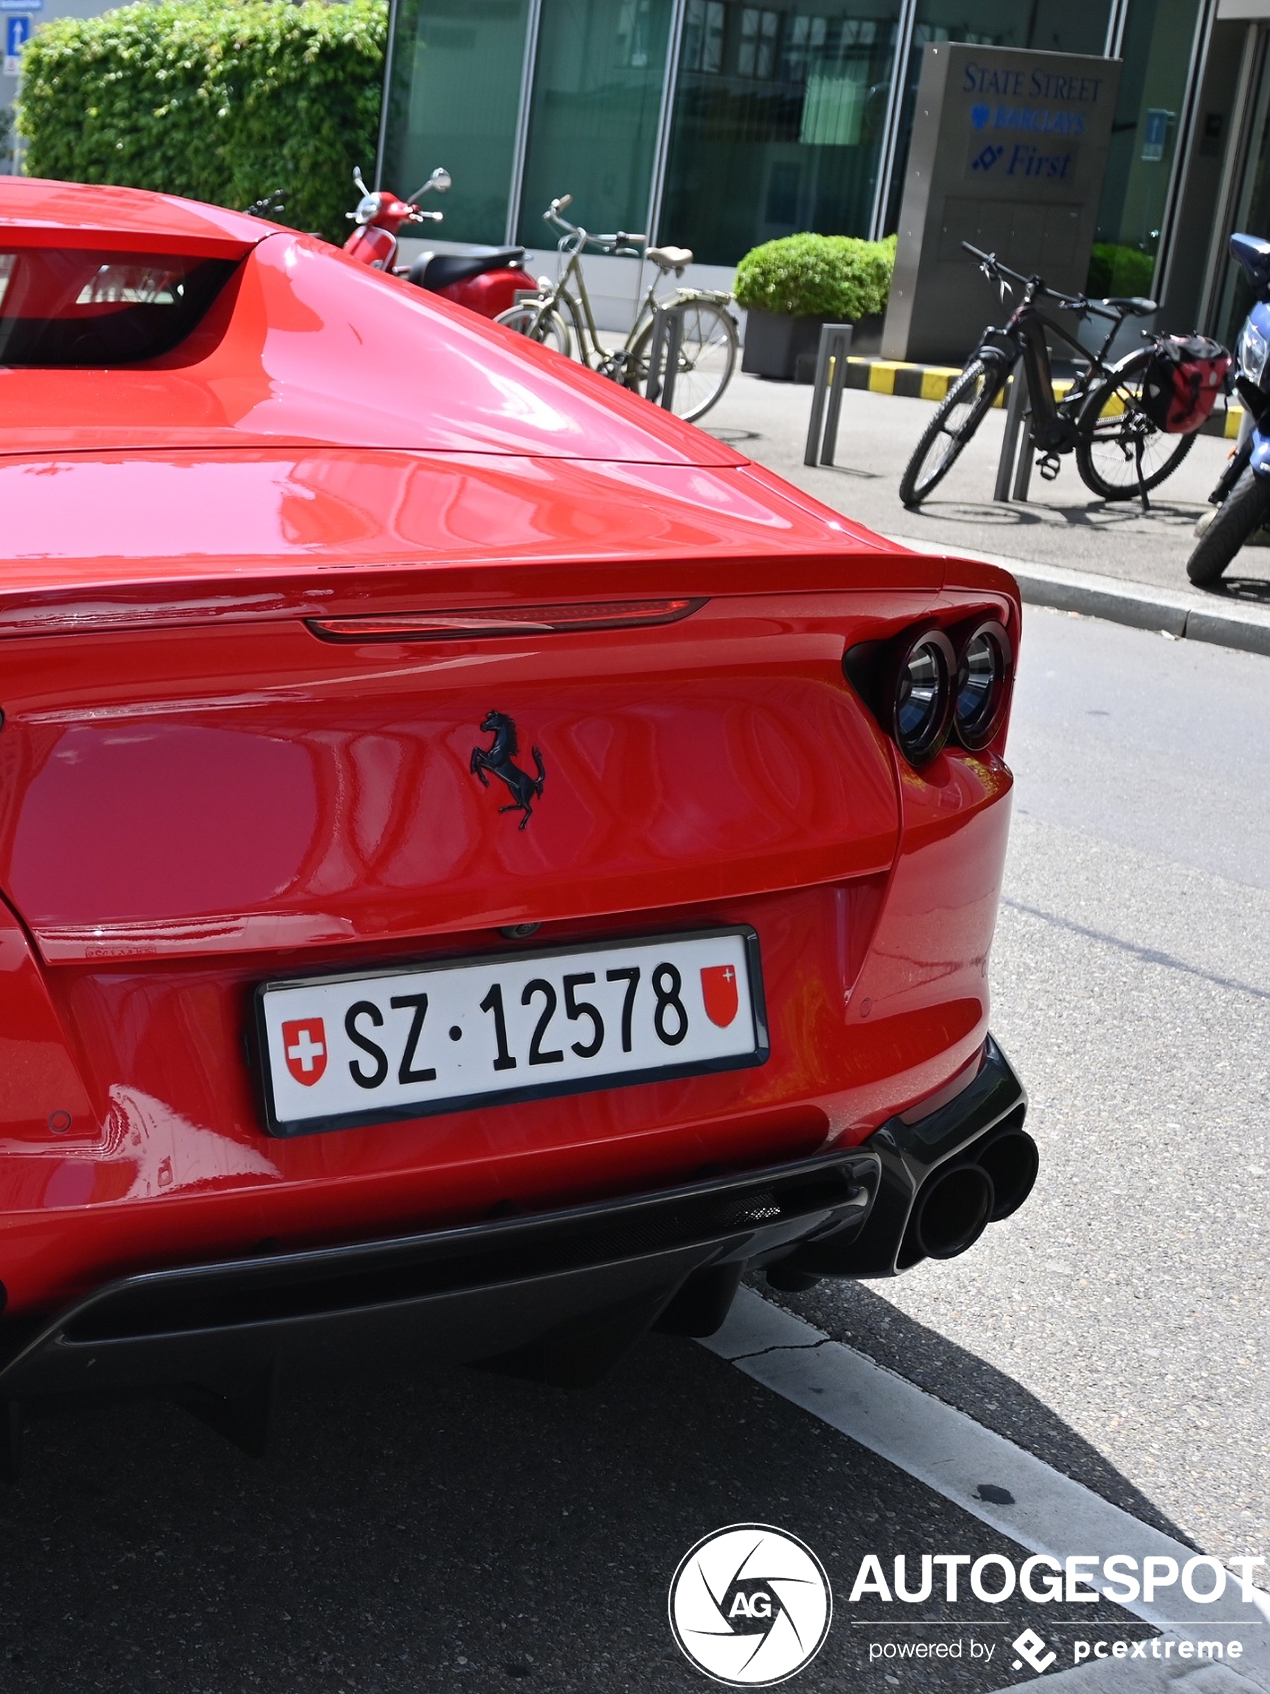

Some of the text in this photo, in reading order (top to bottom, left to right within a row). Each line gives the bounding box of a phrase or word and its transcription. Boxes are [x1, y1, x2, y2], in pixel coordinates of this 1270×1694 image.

[963, 62, 1104, 102] STATE STREET
[993, 107, 1086, 135] BARCLAYS
[1006, 144, 1073, 179] First
